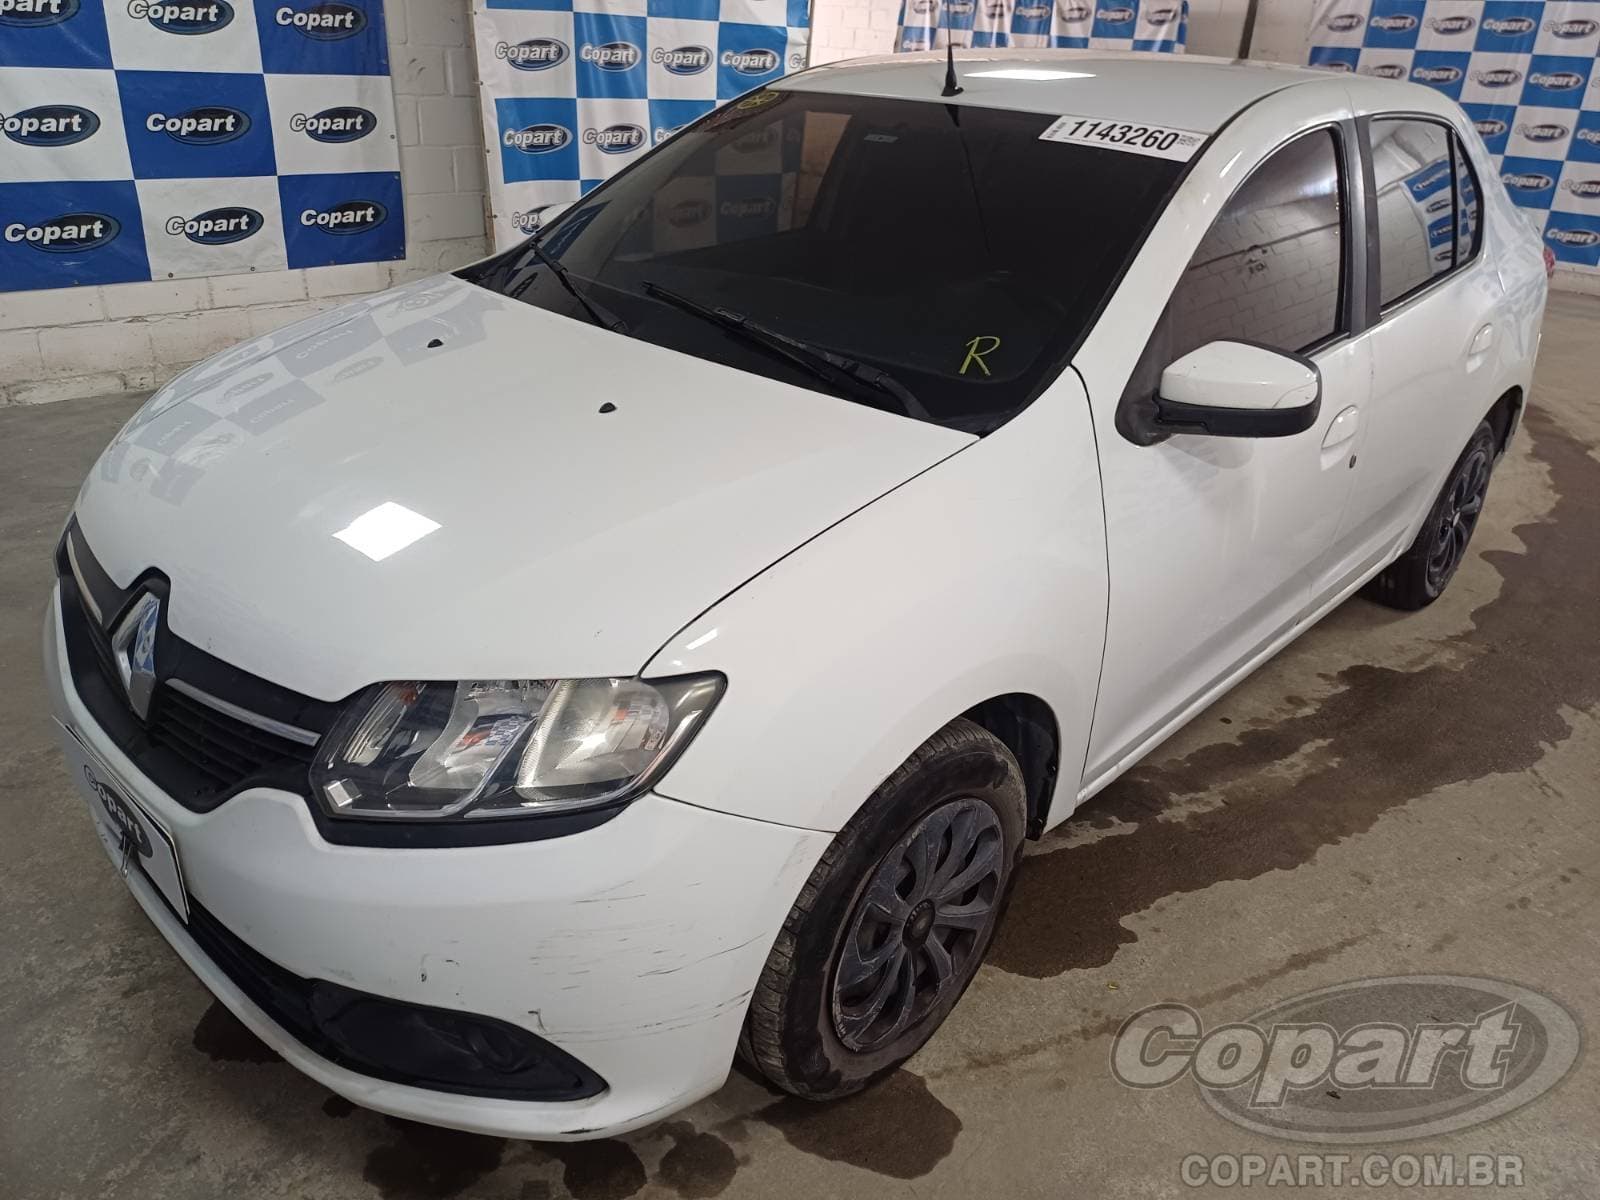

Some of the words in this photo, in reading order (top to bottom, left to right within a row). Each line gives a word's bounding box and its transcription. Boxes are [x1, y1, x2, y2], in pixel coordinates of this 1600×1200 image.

[128, 0, 219, 24] Copart
[276, 8, 354, 30] Copart
[1483, 19, 1531, 32] Copart
[1543, 21, 1592, 34] Copart
[496, 42, 560, 62] Copart
[581, 44, 634, 64] Copart
[651, 47, 707, 67] Copart
[721, 51, 773, 70] Copart
[1529, 72, 1576, 86] Copart
[0, 113, 82, 136] opart
[146, 113, 236, 135] Copart
[290, 112, 363, 133] Copart
[1516, 124, 1560, 138] Copart
[503, 128, 562, 147] Copart
[583, 129, 640, 149] Copart
[1069, 120, 1179, 151] 1143260
[1502, 174, 1547, 188] Copart
[166, 213, 249, 235] Copart
[300, 206, 375, 228] Copart
[5, 219, 103, 244] Copart
[1547, 229, 1595, 243] Copart
[959, 336, 1000, 376] R
[84, 764, 143, 844] Copart
